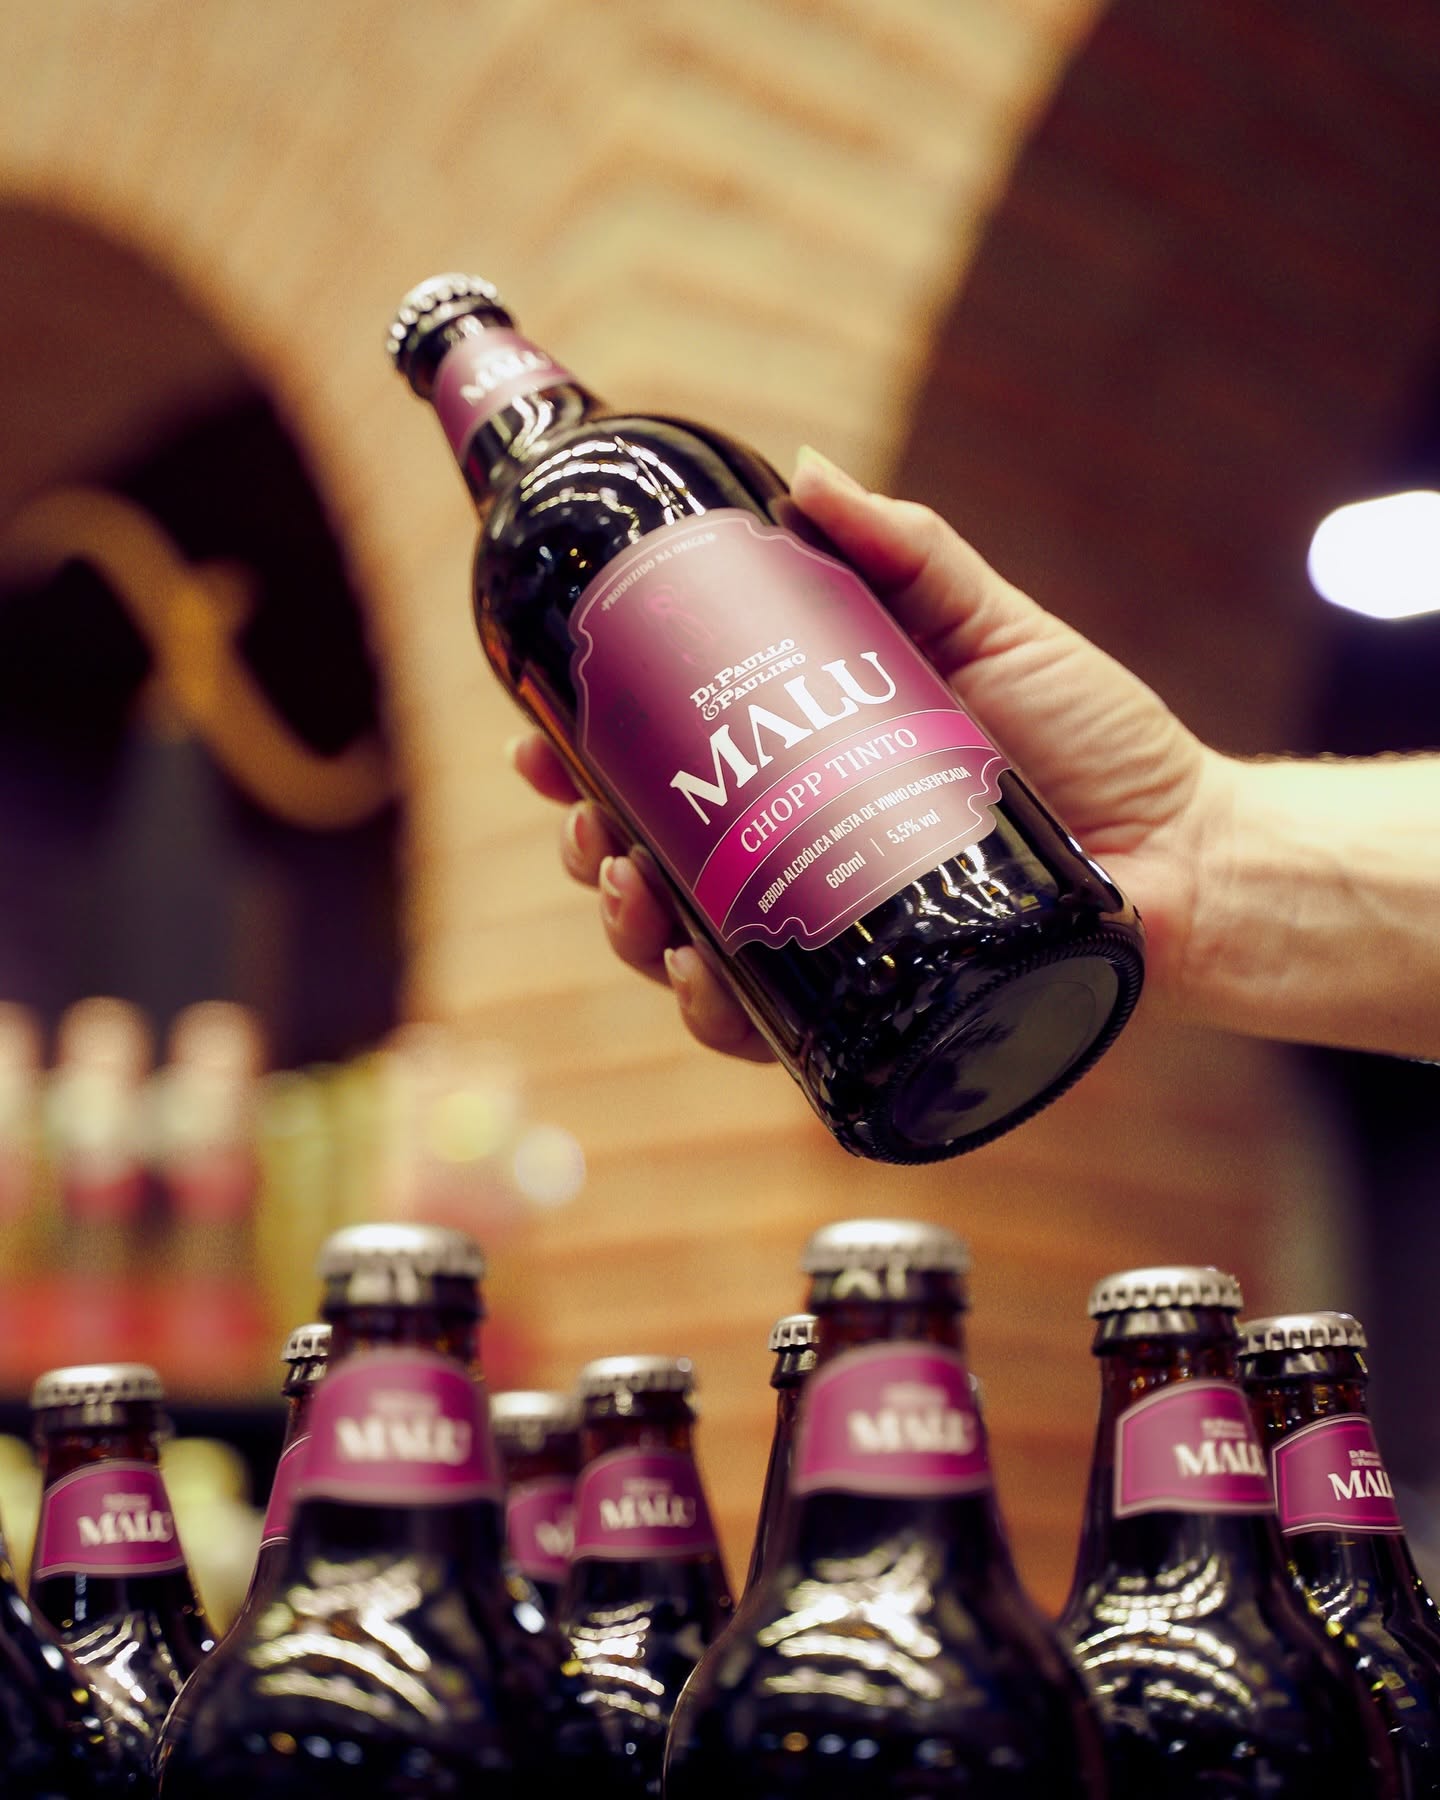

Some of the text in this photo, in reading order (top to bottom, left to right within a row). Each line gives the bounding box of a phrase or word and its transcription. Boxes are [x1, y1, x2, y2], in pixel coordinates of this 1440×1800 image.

[669, 651, 897, 825] MALU
[740, 728, 918, 853] CHOPP TINTO
[757, 766, 972, 914] BEBIDA ALCOÓLICA MISTA DE VINHO GASEIFICADA
[825, 808, 942, 889] 600ml 5,5% vol
